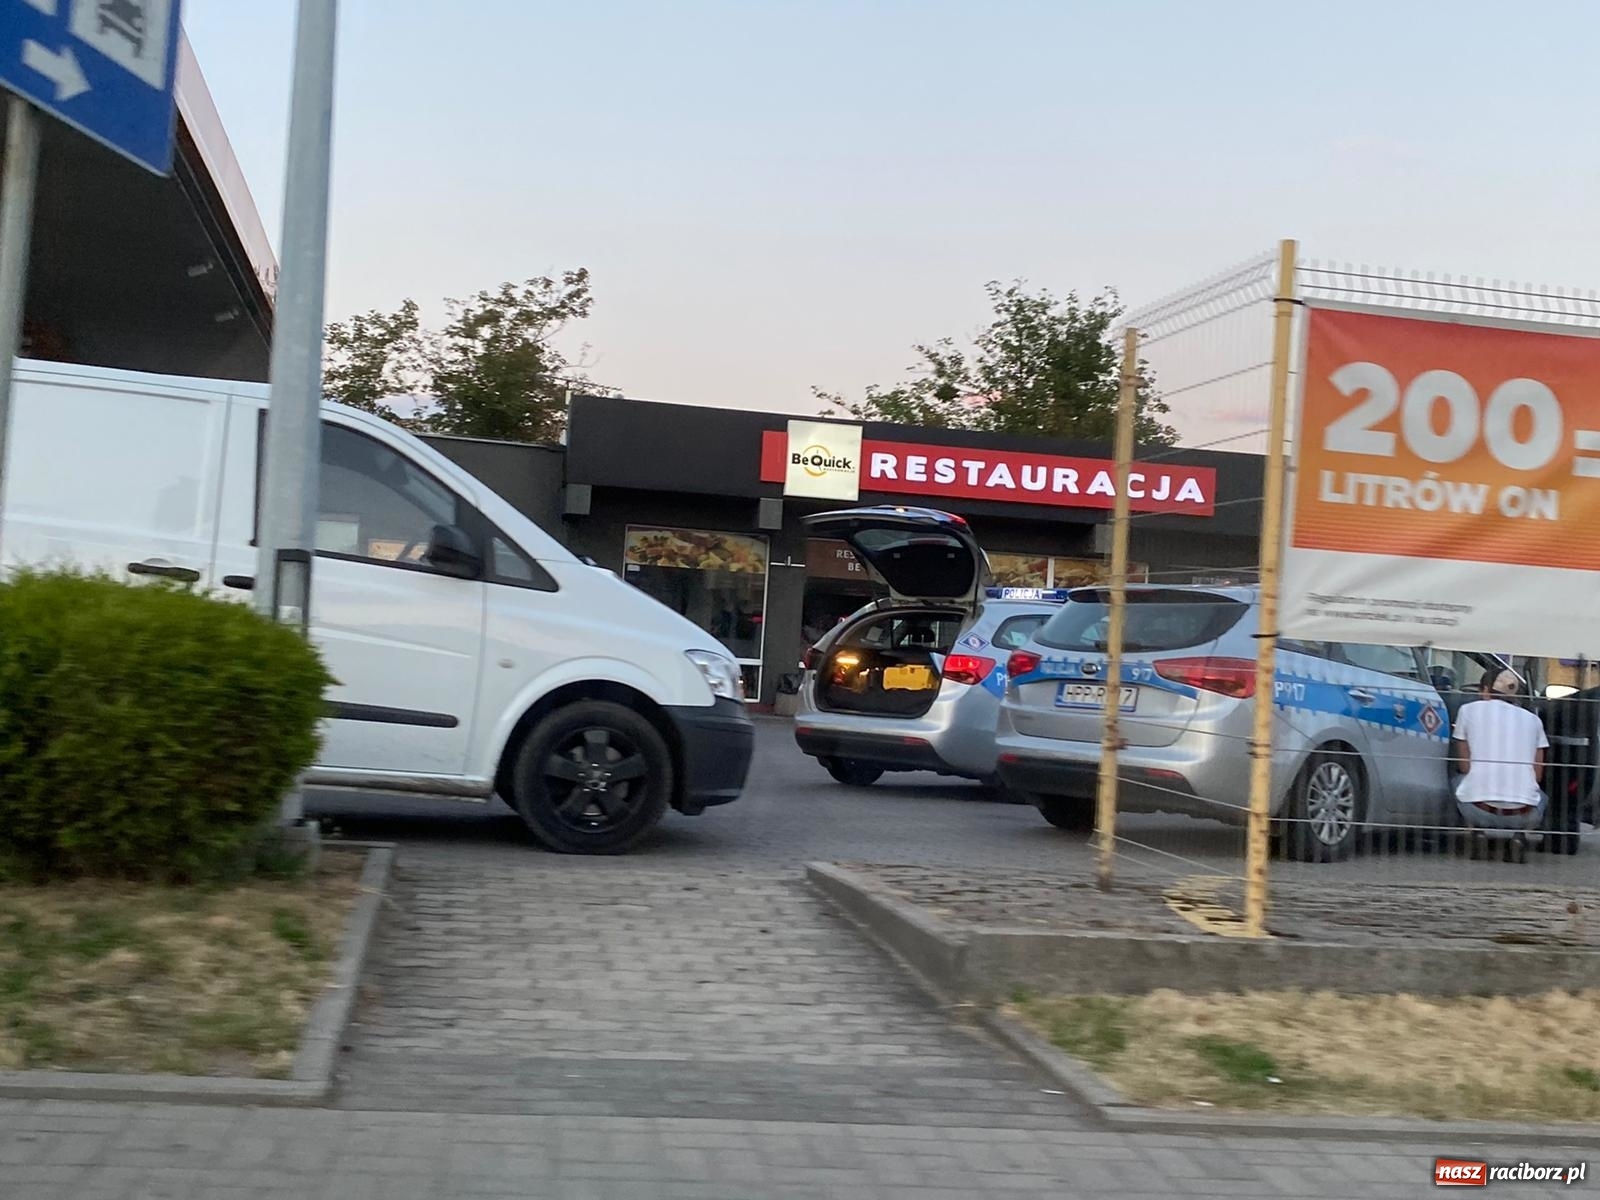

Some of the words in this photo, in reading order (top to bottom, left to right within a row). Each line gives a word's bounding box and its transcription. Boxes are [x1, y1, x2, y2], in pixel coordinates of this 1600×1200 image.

[869, 451, 1206, 504] RESTAURACJA
[1319, 469, 1491, 515] LITRÓW
[1498, 484, 1560, 521] ON
[1004, 588, 1041, 600] POLICJA
